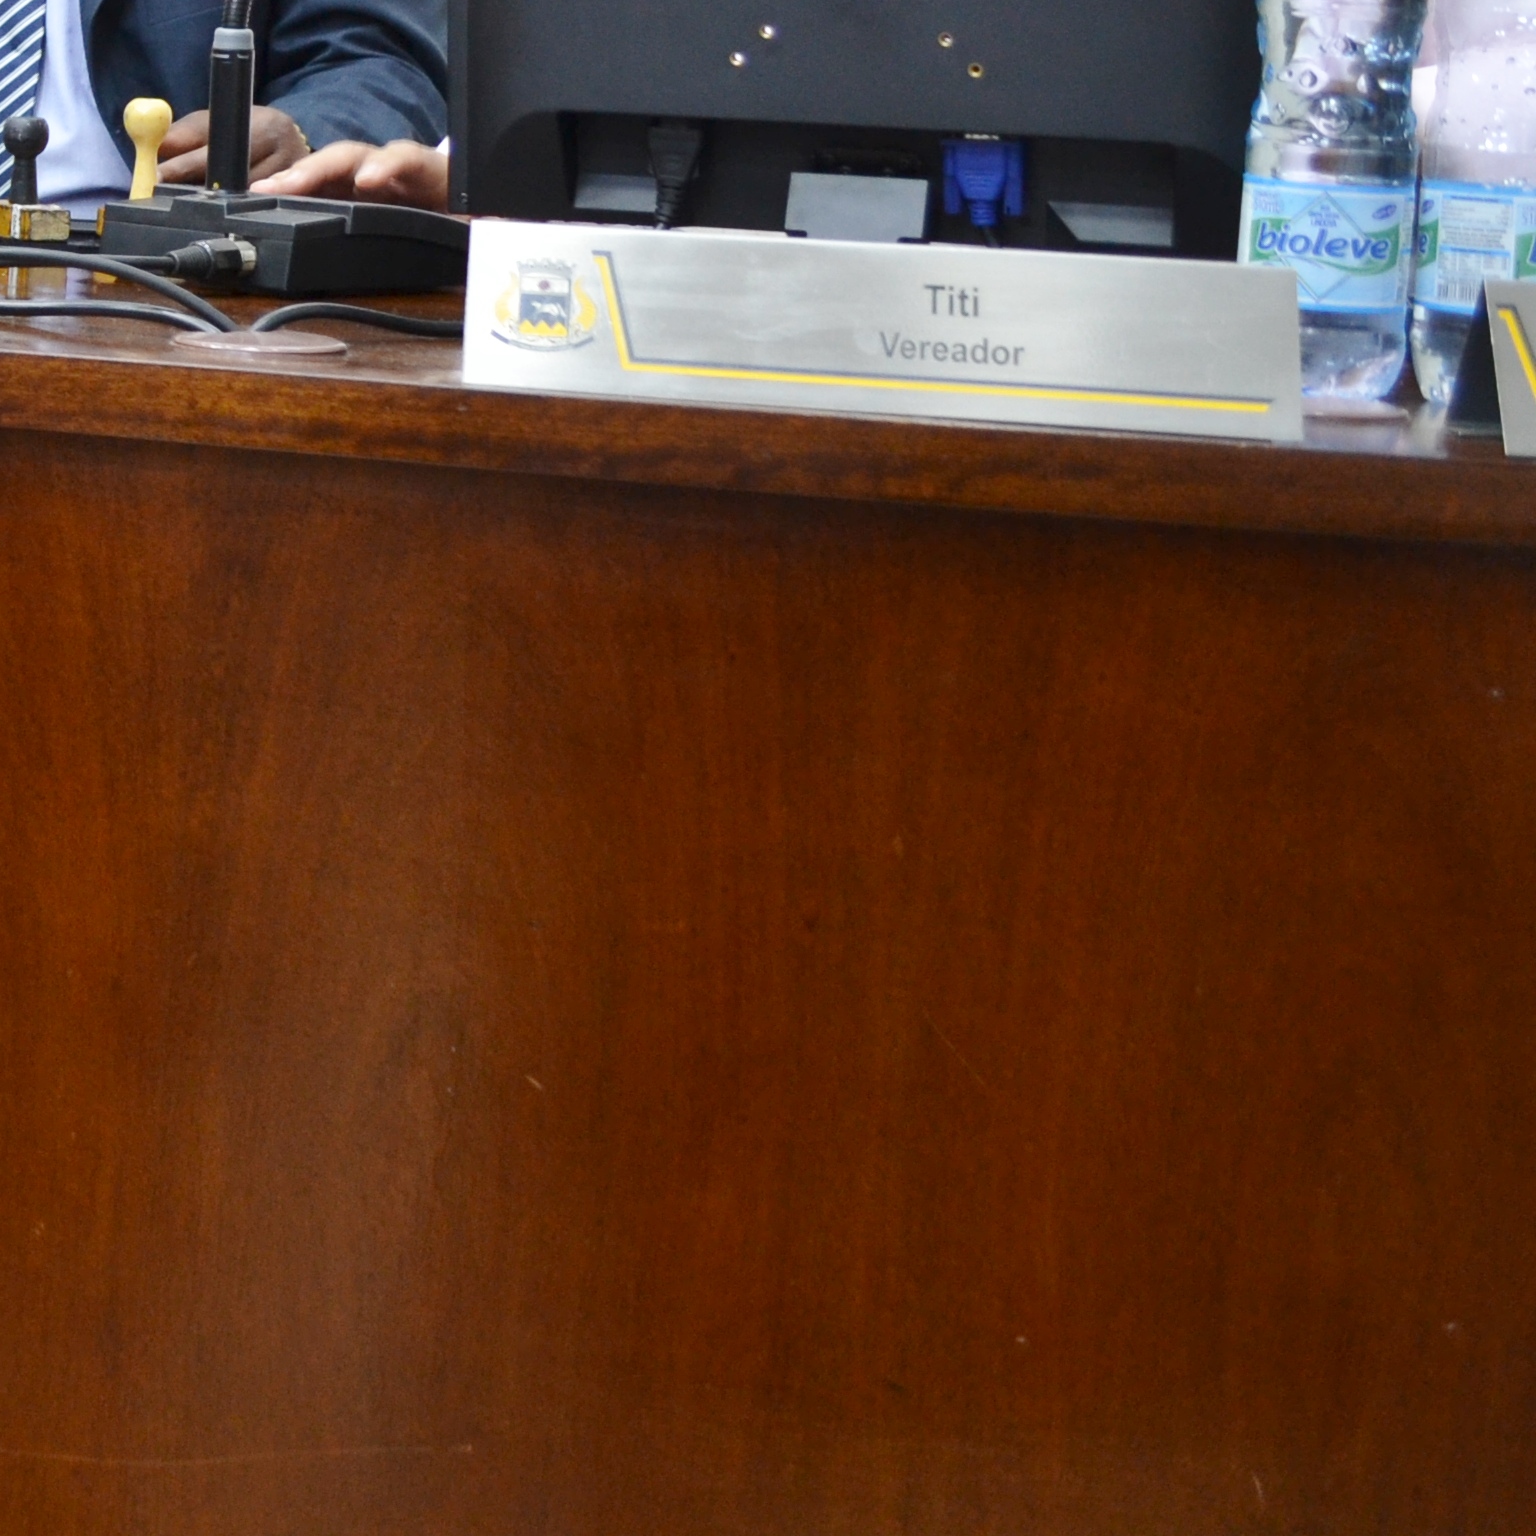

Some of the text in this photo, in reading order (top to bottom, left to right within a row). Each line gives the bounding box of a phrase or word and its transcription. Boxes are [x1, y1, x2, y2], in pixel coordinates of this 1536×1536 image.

[1256, 222, 1390, 260] bioleve
[923, 284, 980, 317] Titi
[879, 331, 1025, 366] Vereador
